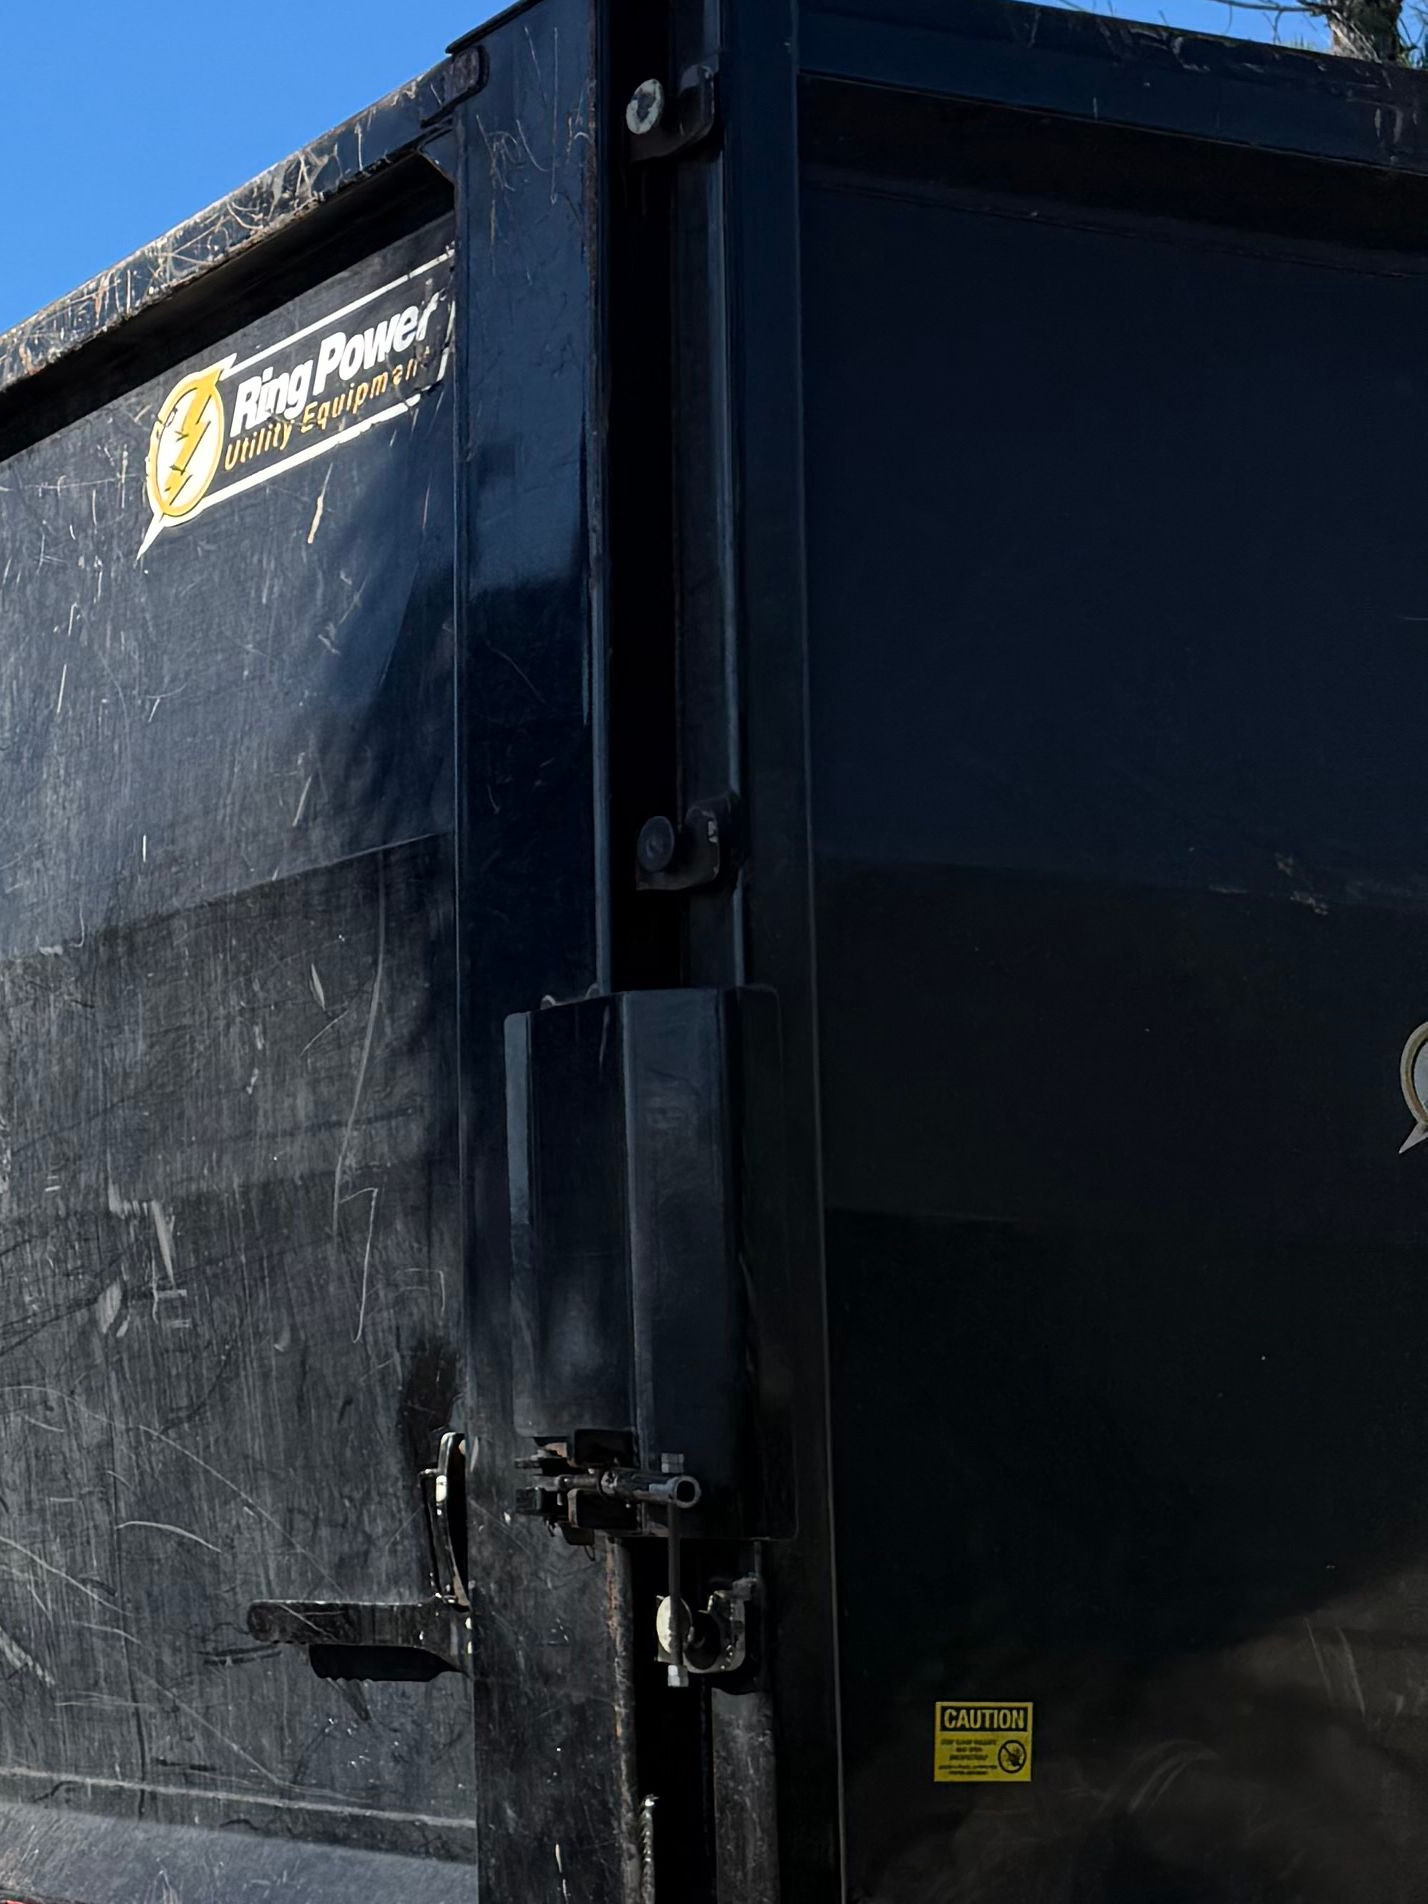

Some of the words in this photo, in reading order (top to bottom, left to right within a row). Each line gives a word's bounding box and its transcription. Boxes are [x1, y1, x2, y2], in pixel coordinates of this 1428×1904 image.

[224, 419, 294, 471] Utility
[299, 356, 425, 434] Equipmen
[230, 358, 313, 439] Ring
[313, 288, 446, 397] Power
[943, 1708, 1025, 1729] CAUTION
